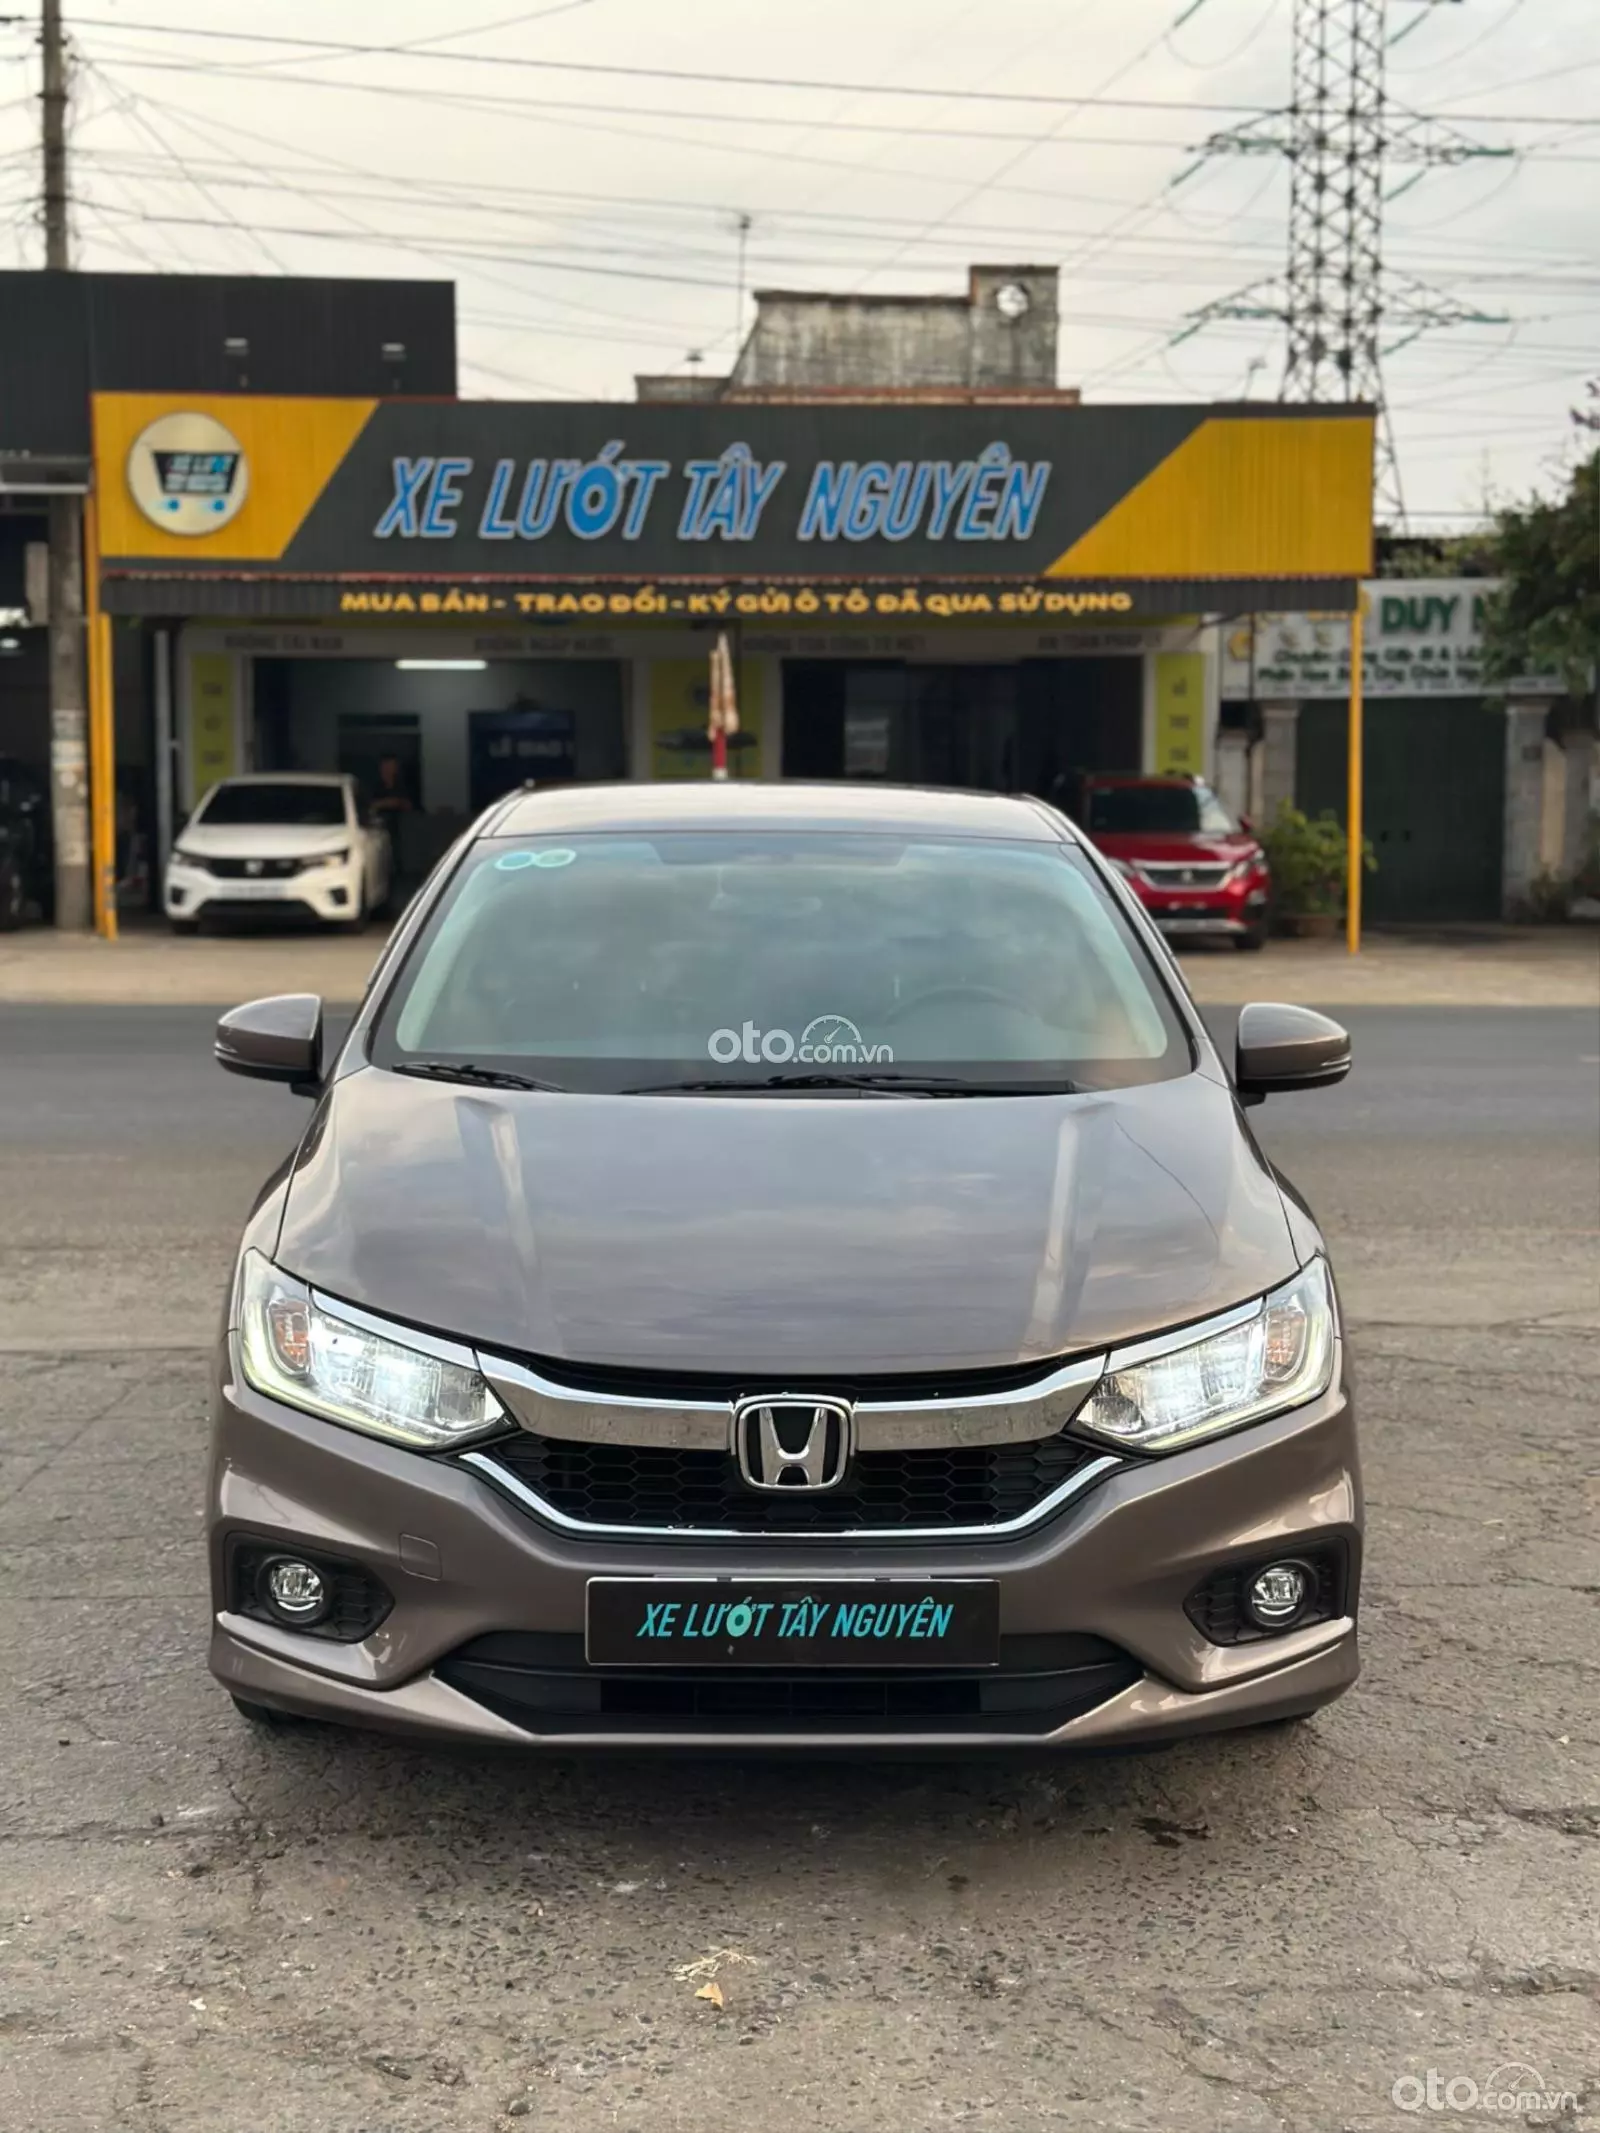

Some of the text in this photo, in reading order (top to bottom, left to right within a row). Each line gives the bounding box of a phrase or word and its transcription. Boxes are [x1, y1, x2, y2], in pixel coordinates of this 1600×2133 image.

[375, 439, 1051, 541] XE LƯỚT TÂY NGUYÊN
[340, 593, 415, 613] MUA
[419, 587, 489, 613] BÁN
[515, 593, 606, 613] TRAO
[925, 593, 993, 616] QUA
[1044, 591, 1133, 617] DỤNG
[1382, 596, 1459, 634] DUY
[636, 1595, 955, 1638] XE LƯỚT TÂY NGUYÊN
